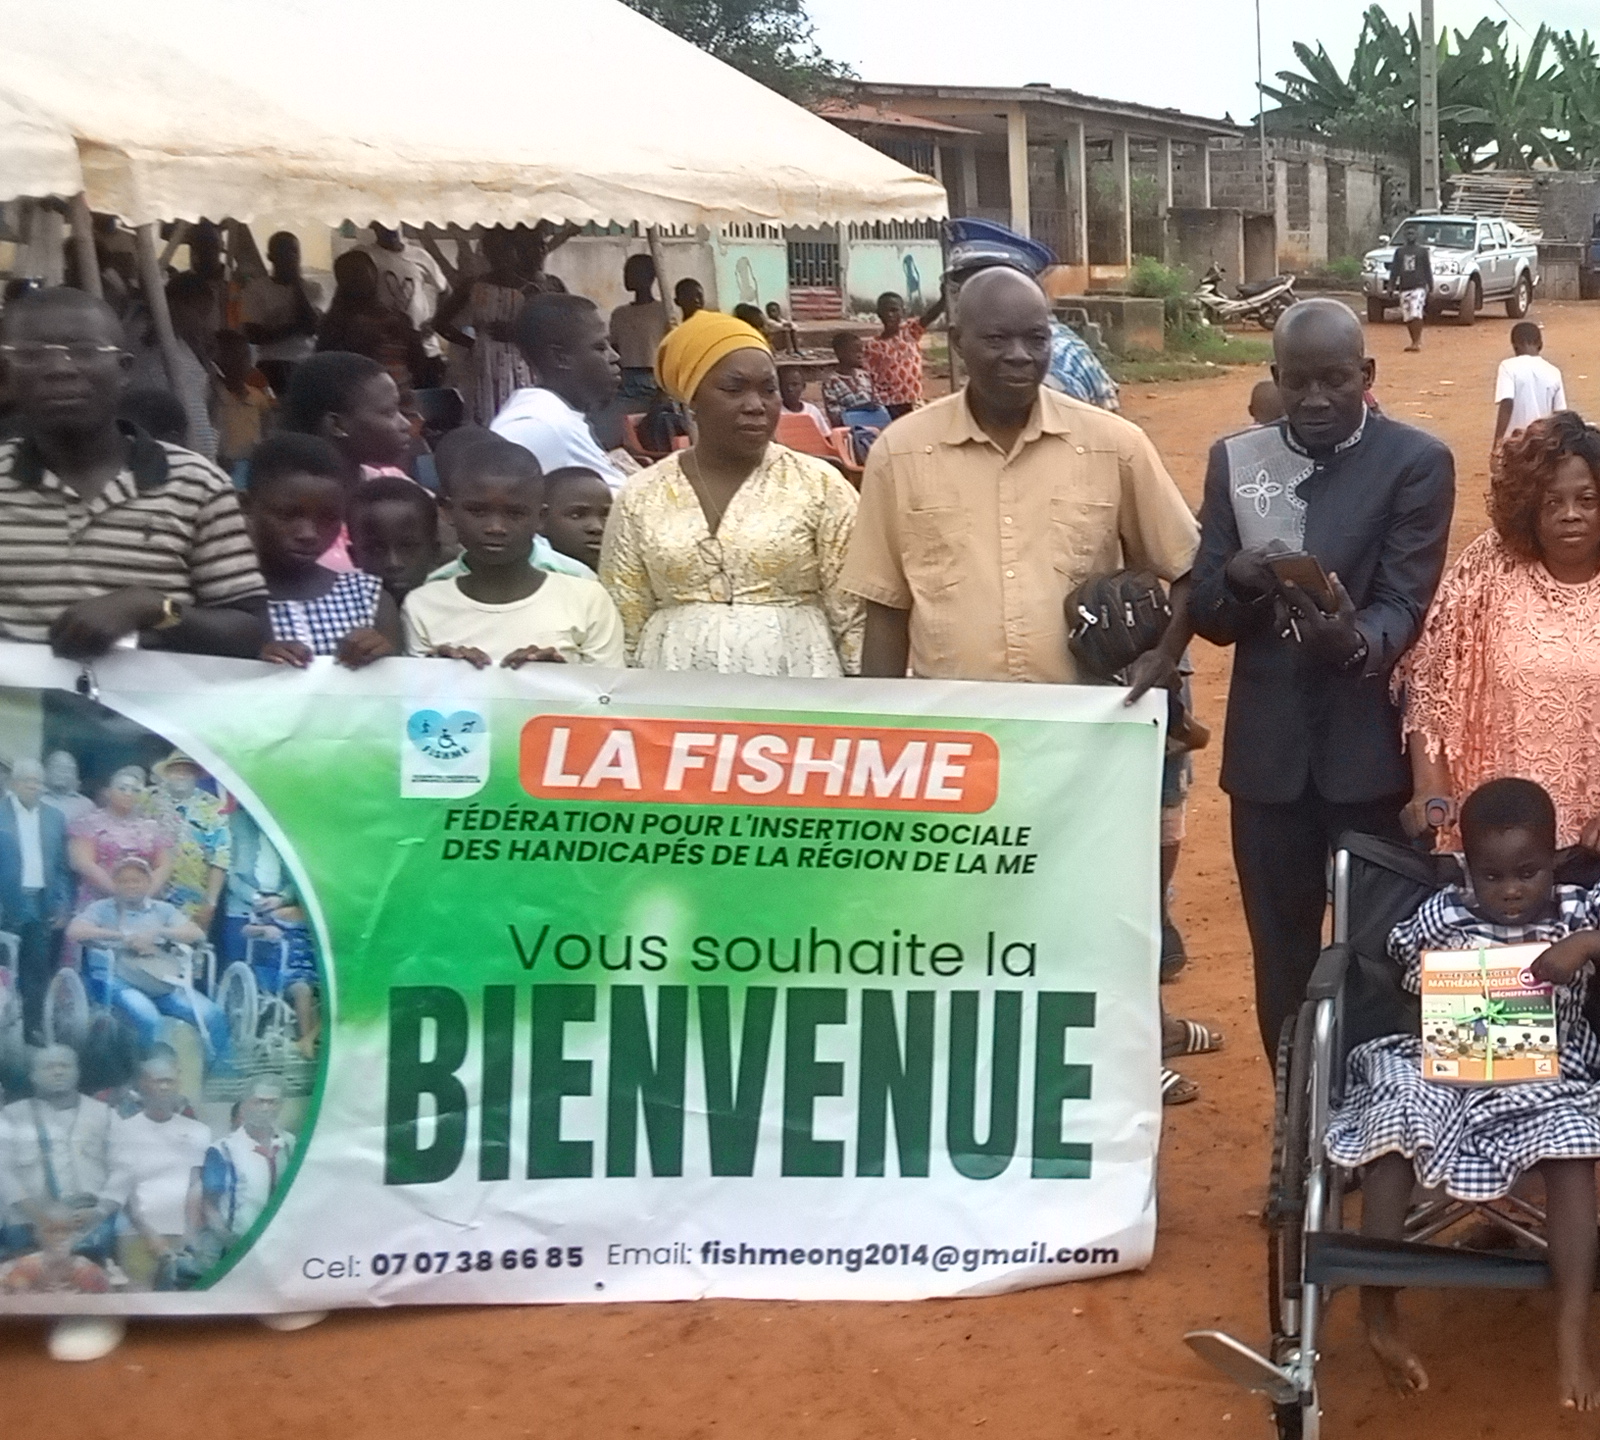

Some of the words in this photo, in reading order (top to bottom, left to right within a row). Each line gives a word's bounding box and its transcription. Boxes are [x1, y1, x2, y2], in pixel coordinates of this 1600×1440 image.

[542, 727, 642, 790] LA
[664, 732, 974, 801] FISHME
[444, 803, 635, 834] FÉDÉRATION
[641, 813, 724, 837] POUR
[730, 814, 904, 842] L'INSERTION
[910, 822, 1031, 847] SOCIALE
[442, 838, 501, 861] DES
[507, 837, 706, 865] HANDICAPÉS
[711, 845, 750, 867] DE
[755, 847, 789, 868] LA
[797, 842, 914, 871] RÉGION
[912, 851, 950, 873] DE
[954, 853, 988, 874] LA
[995, 854, 1038, 875] ME
[507, 924, 669, 971] Vous
[690, 927, 965, 977] souhaite
[985, 931, 1038, 977] la
[383, 983, 1097, 1186] BIENVENUE
[302, 1255, 361, 1280] Cel:
[371, 1253, 407, 1275] 07
[413, 1252, 450, 1274] 07
[456, 1250, 493, 1273] 38
[501, 1248, 538, 1270] 66
[546, 1246, 584, 1268] 85
[607, 1242, 692, 1266] Email:
[701, 1240, 1119, 1273] fishmeong2014@gmail.com
